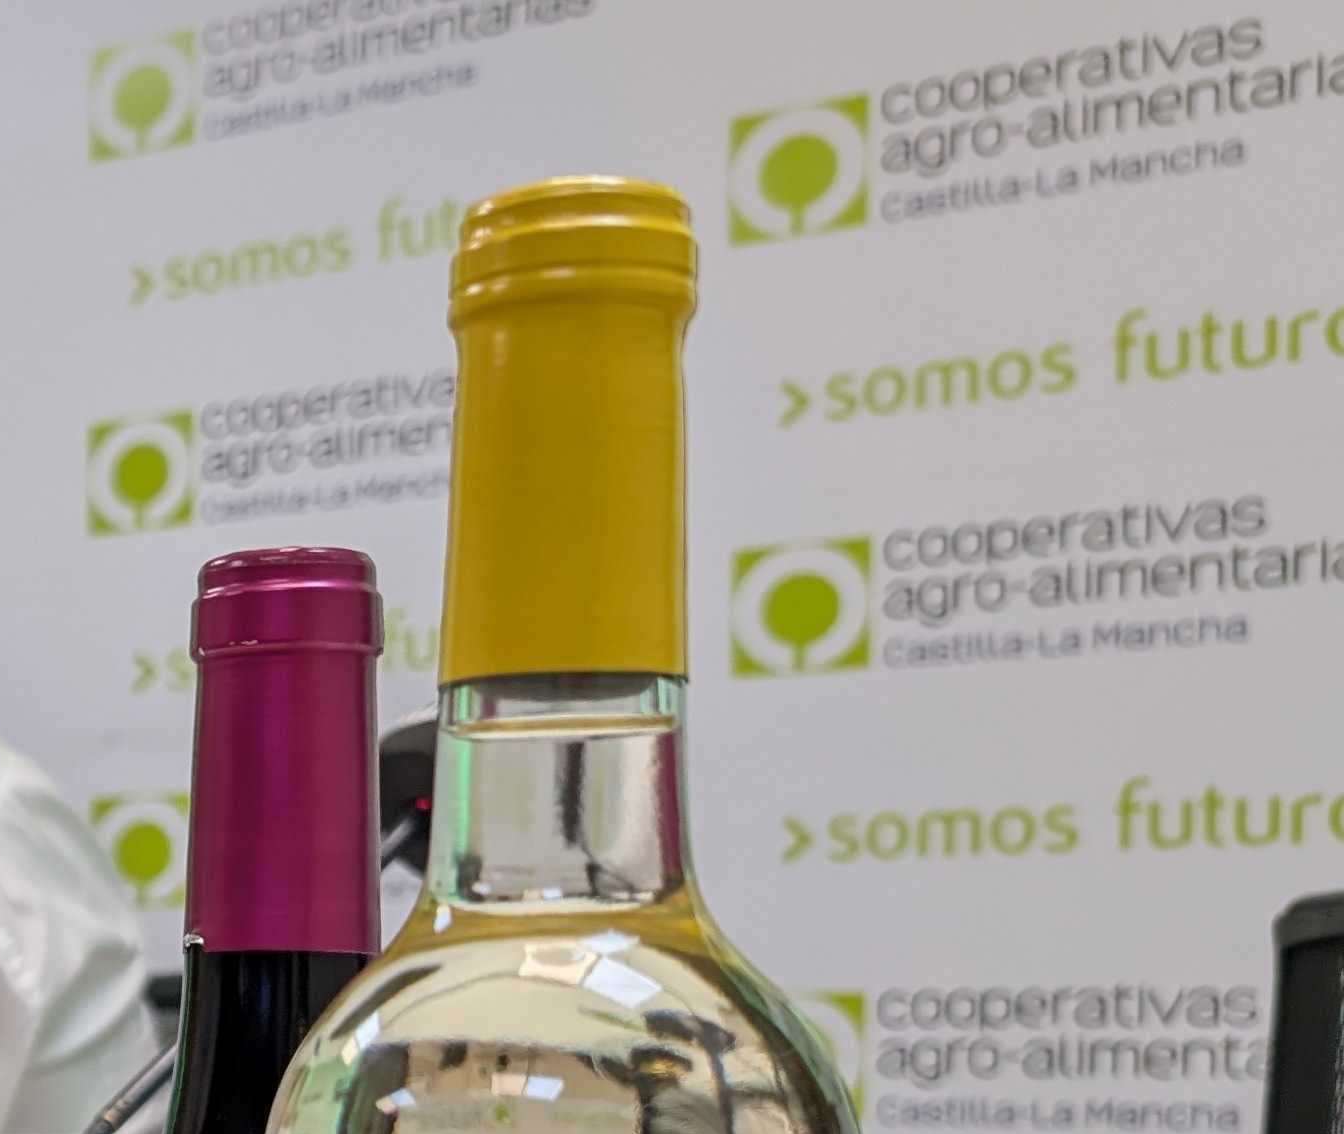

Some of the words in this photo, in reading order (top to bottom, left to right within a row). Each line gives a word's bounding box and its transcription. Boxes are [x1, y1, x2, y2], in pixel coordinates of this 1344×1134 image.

[879, 15, 1263, 125] cooperativas
[879, 158, 1080, 224] Castilla-La
[1089, 134, 1247, 186] Mancha
[376, 196, 462, 262] fut
[200, 368, 453, 440] cooperativa
[201, 417, 452, 488] agro-alimen
[354, 465, 450, 497] Manch
[881, 493, 1267, 572] cooperativas
[882, 623, 1085, 672] Castilla-La
[1093, 611, 1250, 657] Mancha
[875, 984, 1259, 1031] cooperativas
[875, 1033, 1270, 1090] agro-alimenta
[874, 1093, 1075, 1131] Castilla-La
[1085, 1101, 1242, 1134] Mancha
